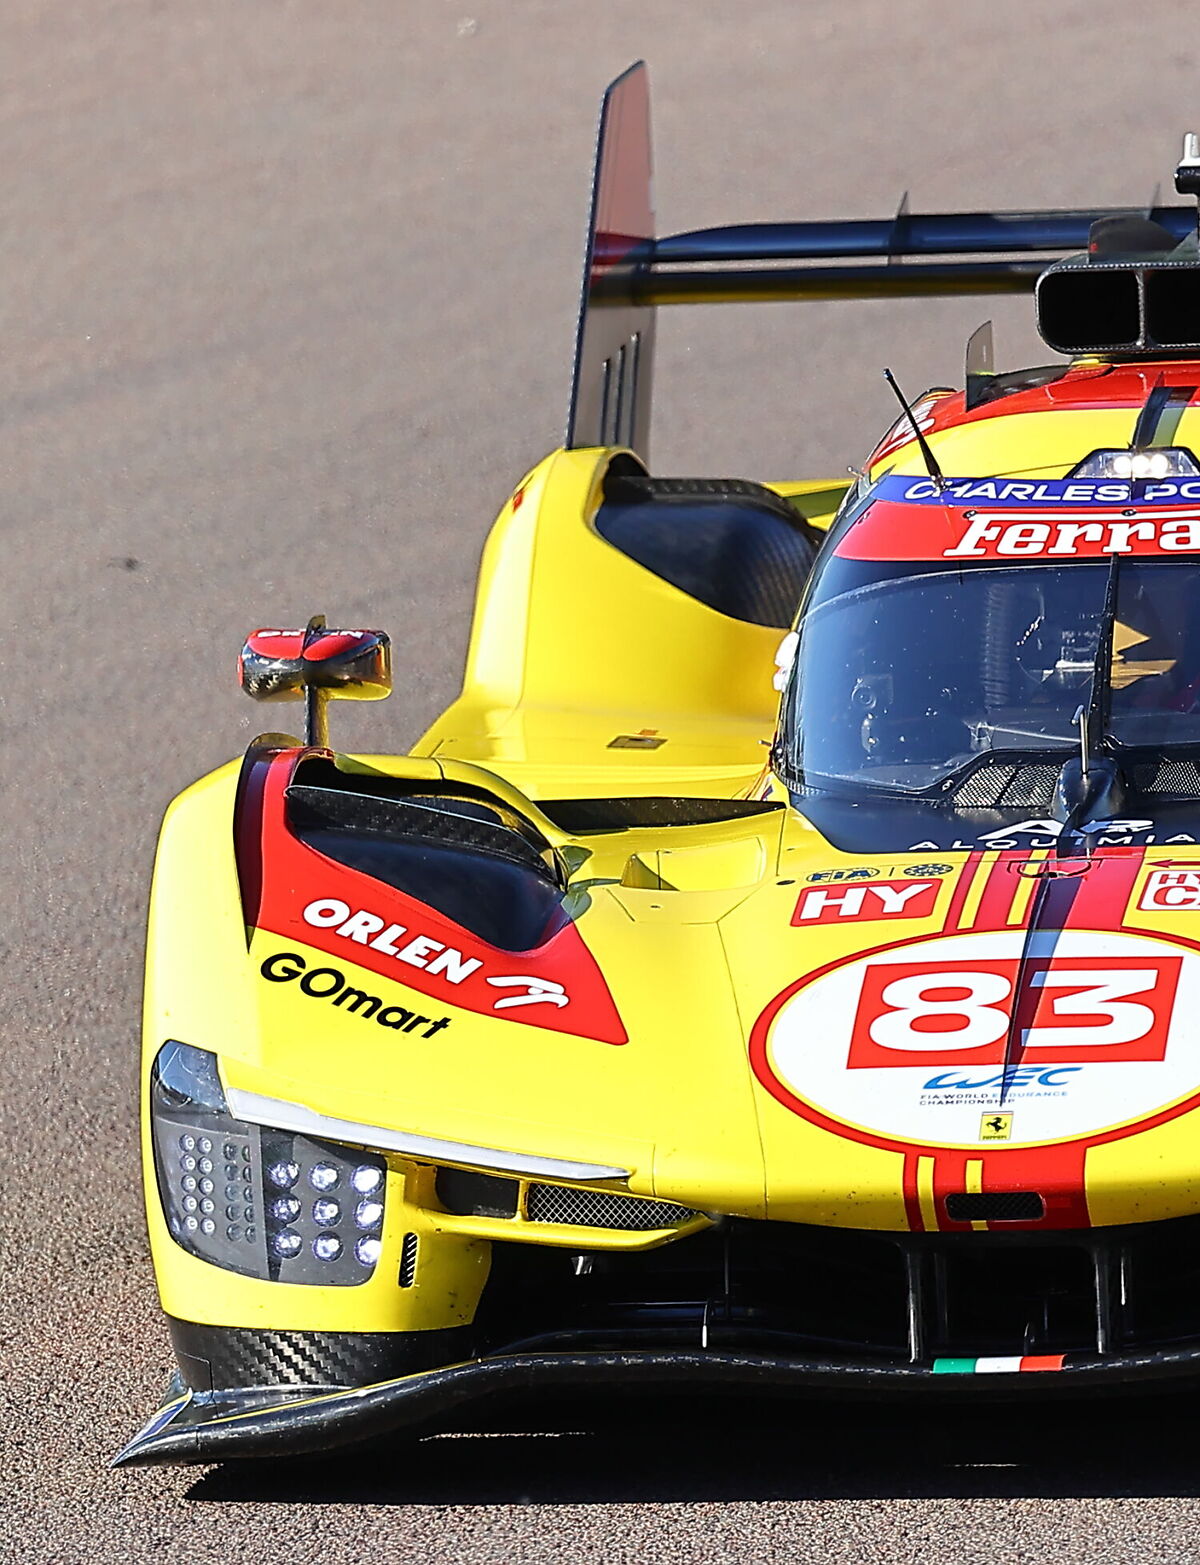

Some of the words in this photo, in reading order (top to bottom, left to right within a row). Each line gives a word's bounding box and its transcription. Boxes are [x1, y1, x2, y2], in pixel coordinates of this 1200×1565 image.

[904, 481, 1129, 502] CHARLES
[909, 833, 1197, 850] ALQUIMIA
[811, 869, 872, 882] FIA
[800, 883, 933, 920] HY
[303, 898, 484, 985] ORLEN
[260, 952, 453, 1039] GOmart
[868, 968, 1159, 1053] 83
[923, 1066, 1083, 1090] WEC
[992, 1091, 1069, 1099] EDURANCE
